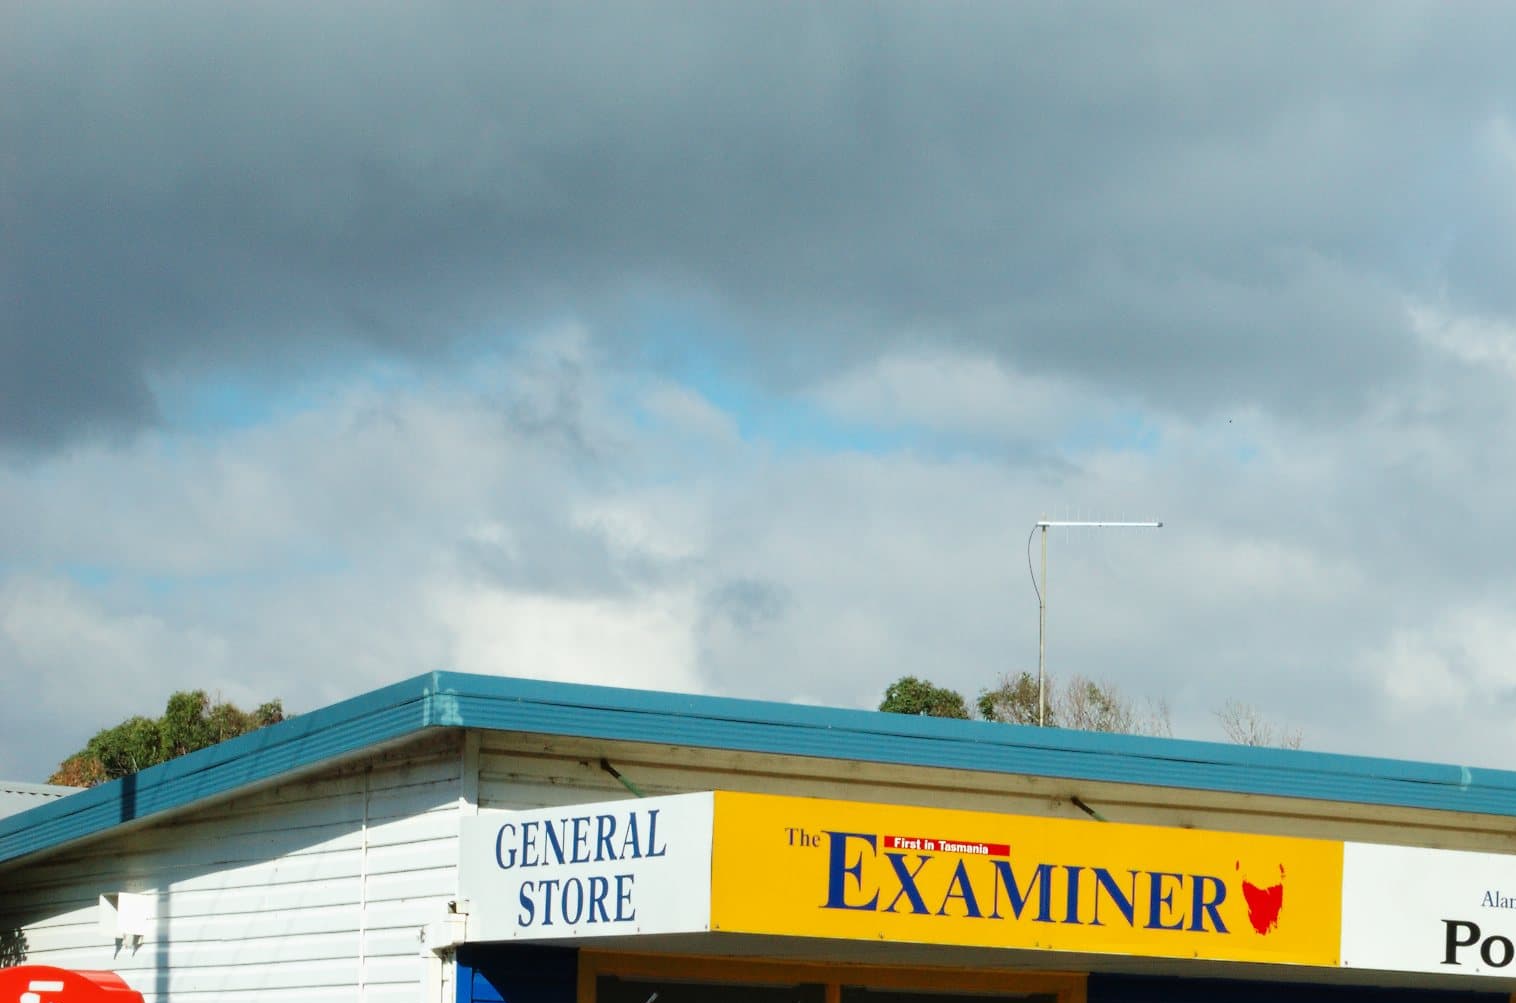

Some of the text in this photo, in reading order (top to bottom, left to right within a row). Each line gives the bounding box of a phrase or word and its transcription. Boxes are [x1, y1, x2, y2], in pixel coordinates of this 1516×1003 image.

[495, 809, 667, 869] GENERAL
[785, 827, 821, 849] The
[894, 837, 989, 855] First in Tasmania
[518, 873, 636, 927] STORE
[818, 830, 1231, 935] EXAMINER
